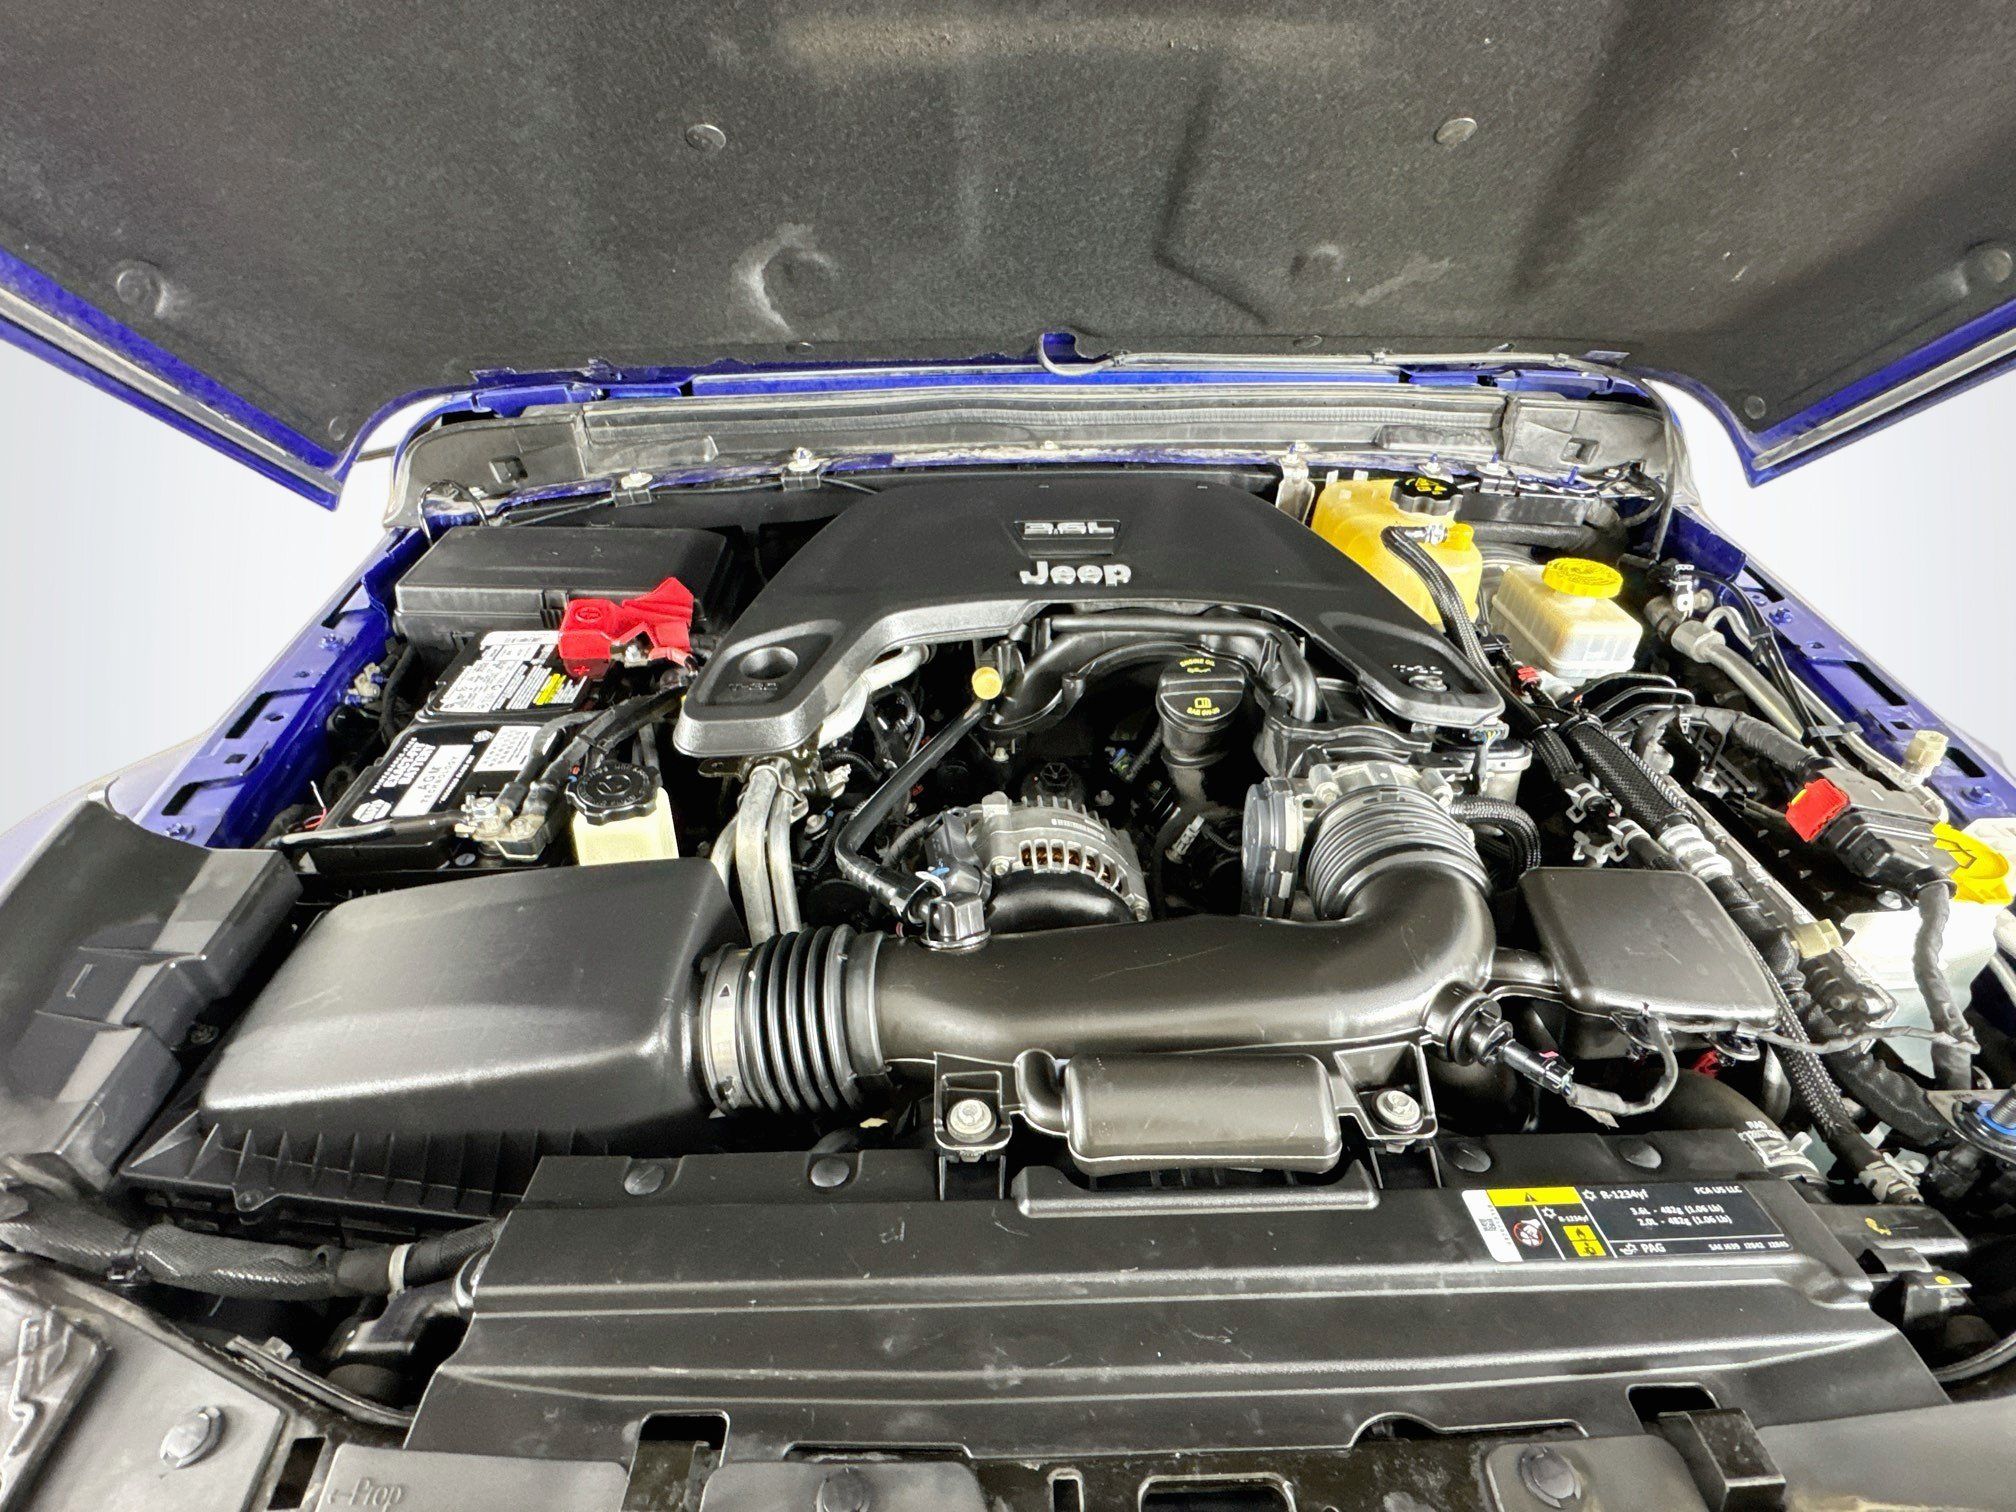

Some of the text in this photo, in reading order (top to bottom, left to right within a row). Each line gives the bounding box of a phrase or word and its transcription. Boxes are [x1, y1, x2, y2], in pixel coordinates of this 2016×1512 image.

[1019, 561, 1132, 587] Jeep
[398, 744, 437, 785] BATTERY
[417, 766, 442, 791] AGM
[1600, 1188, 1649, 1201] R-1234yf
[1694, 1185, 1743, 1195] FCA US LLC
[1629, 1206, 1651, 1216] 3.6L
[1660, 1205, 1684, 1215] 482g
[1636, 1217, 1659, 1227] 2.0L
[1668, 1216, 1692, 1227] 482g
[1640, 1243, 1667, 1255] PAG
